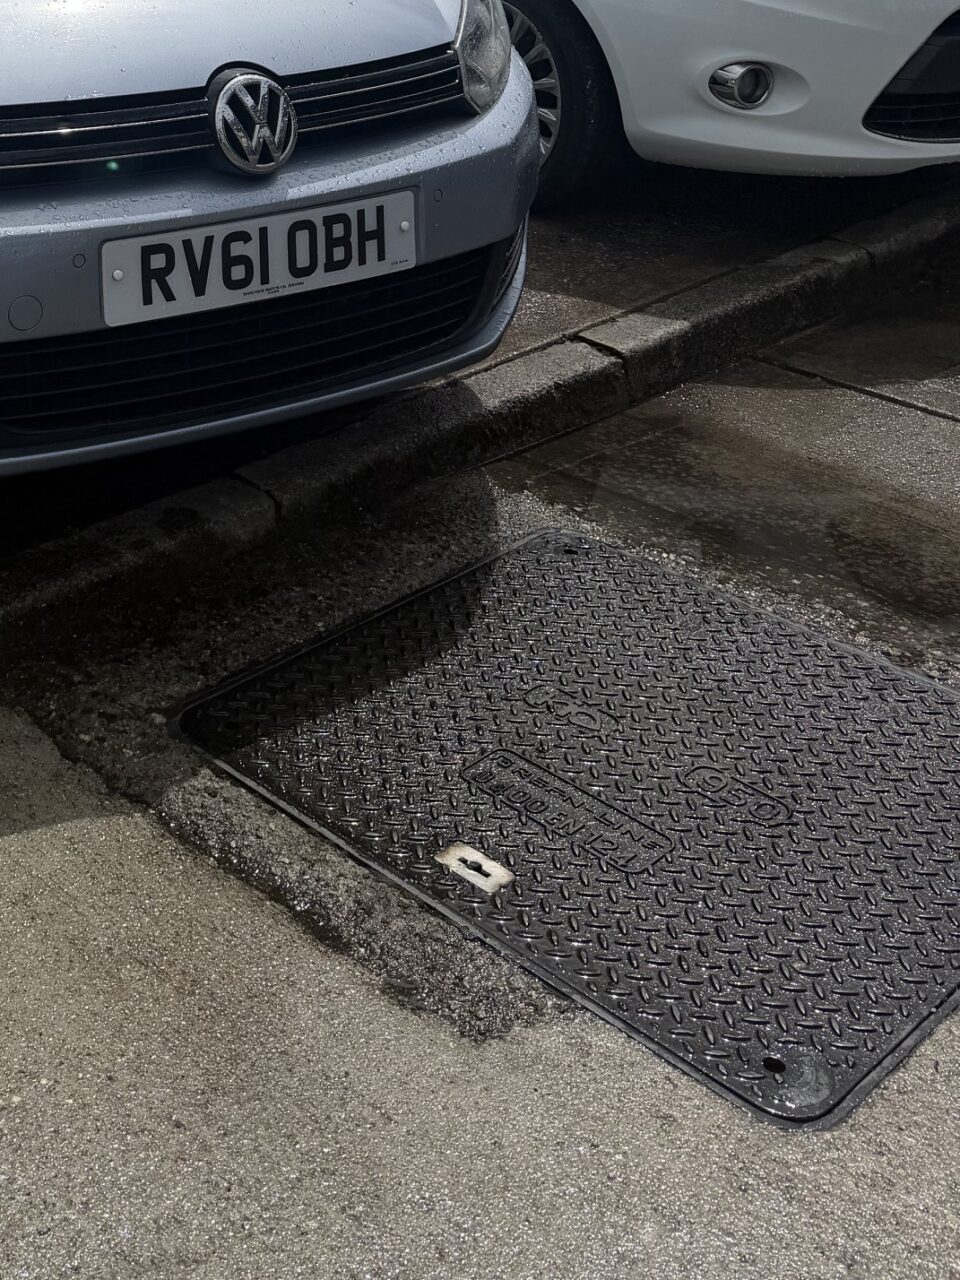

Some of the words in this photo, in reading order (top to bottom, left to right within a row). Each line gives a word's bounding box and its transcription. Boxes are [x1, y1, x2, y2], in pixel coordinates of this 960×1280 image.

[216, 75, 297, 173] VW
[140, 226, 270, 306] RV61
[287, 204, 386, 278] OBH
[696, 774, 781, 820] 950
[544, 811, 586, 836] EN
[583, 831, 638, 867] 124
